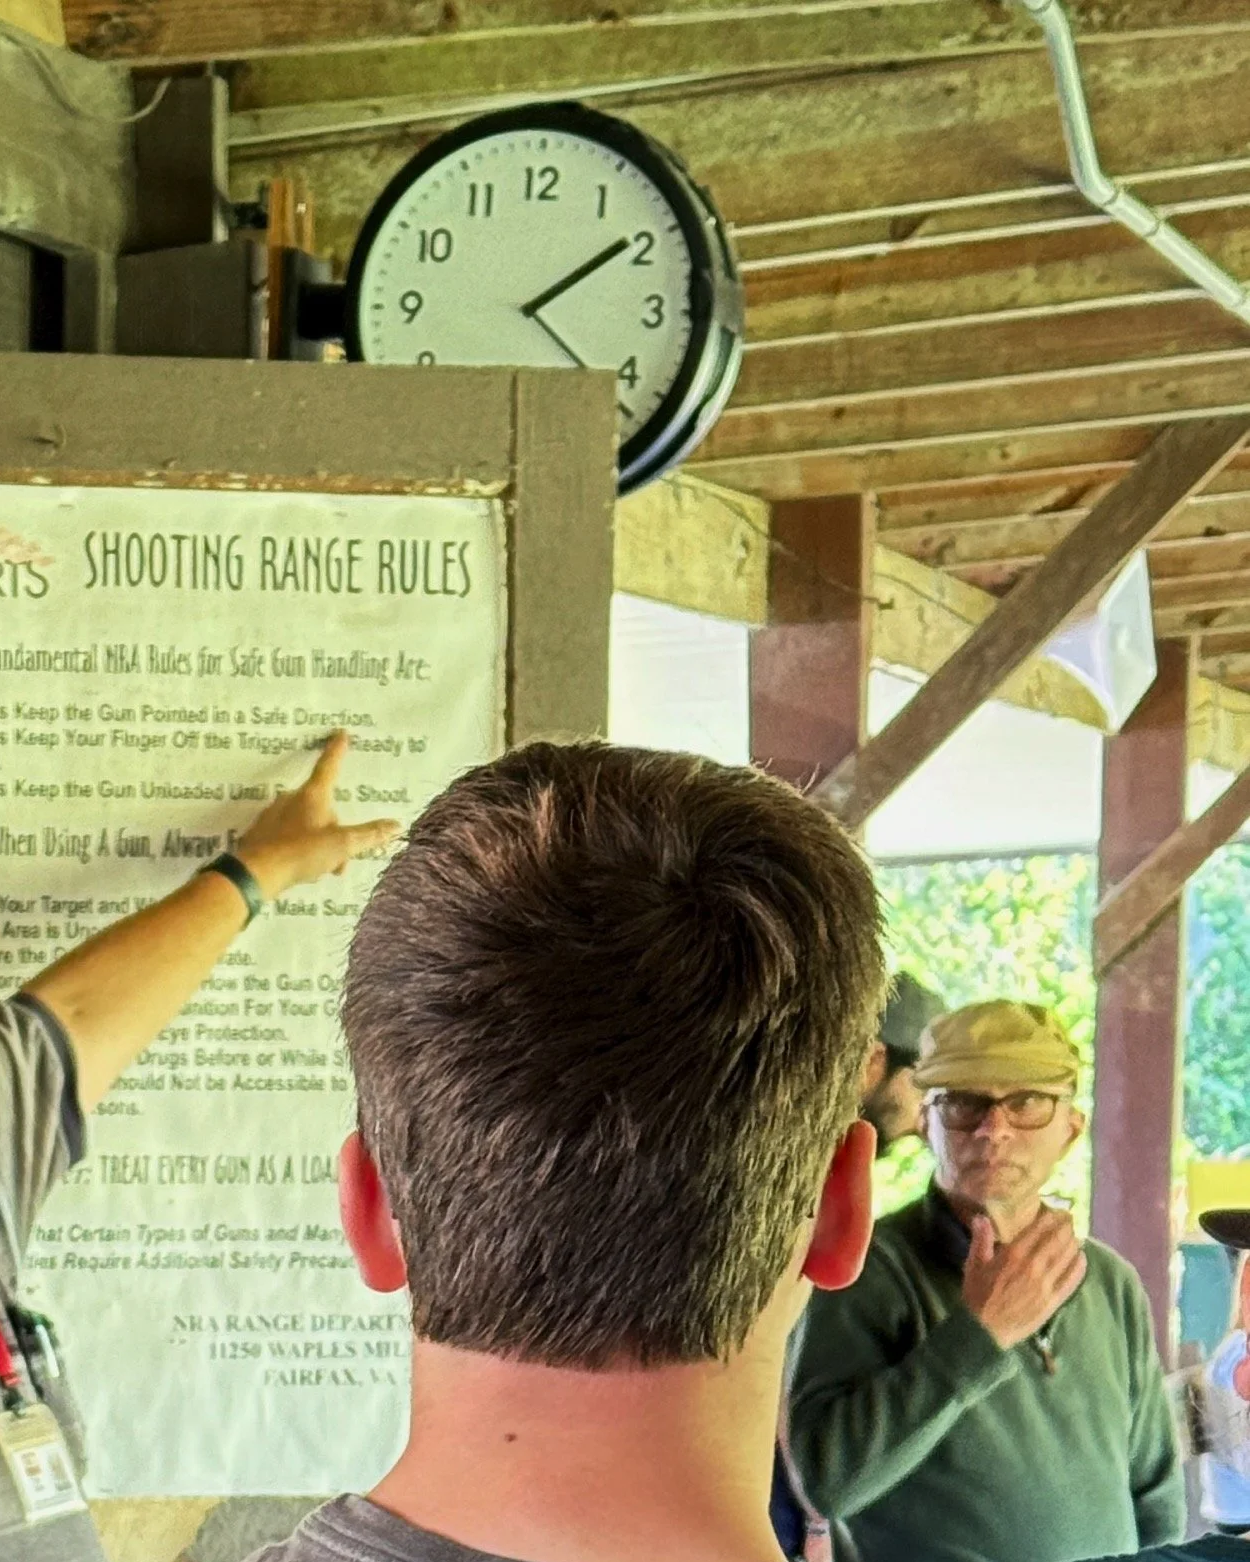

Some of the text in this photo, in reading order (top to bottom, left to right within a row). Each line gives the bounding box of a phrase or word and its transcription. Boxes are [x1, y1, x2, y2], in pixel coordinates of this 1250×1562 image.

[524, 166, 559, 201] 12
[468, 182, 494, 218] 11
[597, 184, 607, 219] 1
[418, 228, 453, 263] 10
[632, 231, 655, 266] 2
[399, 290, 424, 324] 9
[641, 294, 664, 329] 3
[617, 356, 641, 390] 4
[84, 531, 471, 599] SHOOTING RANGE RULES
[104, 643, 141, 674] NRA
[146, 644, 192, 676] Rules
[198, 646, 223, 678] for
[230, 647, 266, 678] Safe
[271, 647, 306, 678] Gun
[311, 648, 390, 686] Handling
[14, 702, 60, 724] Keep
[65, 702, 92, 721] the
[99, 703, 136, 722] Gun
[141, 704, 208, 724] Pointed
[212, 705, 230, 724] in
[234, 709, 246, 724] a
[251, 706, 288, 726] Safe
[14, 728, 60, 751] Keep
[63, 728, 107, 748] Your
[111, 728, 168, 752] Finger
[172, 731, 200, 750] Off
[204, 732, 231, 750] the
[238, 731, 298, 755] Trigger
[14, 779, 60, 801] Keep
[64, 779, 93, 798] the
[99, 780, 136, 799] Gun
[141, 781, 224, 800] Unloaded
[42, 826, 92, 864] Using
[97, 828, 110, 858] A
[40, 896, 94, 918] Target
[98, 898, 130, 914] and
[2, 921, 41, 939] Area
[46, 922, 60, 939] is
[18, 947, 46, 964] the
[243, 974, 270, 991] the
[276, 974, 313, 991] Gun
[243, 999, 274, 1016] For
[278, 999, 319, 1016] Your
[194, 1049, 250, 1067] Before
[256, 1052, 275, 1067] or
[280, 1050, 327, 1067] While
[110, 1073, 164, 1091] hould
[169, 1074, 201, 1091] Not
[205, 1074, 226, 1091] be
[231, 1074, 327, 1092] Accessible
[99, 1154, 150, 1185] TREAT
[157, 1154, 209, 1185] EVERY
[214, 1155, 250, 1185] GUN
[256, 1155, 276, 1185] AS
[282, 1155, 294, 1185] A
[301, 1155, 339, 1185] LOA
[35, 1224, 63, 1242] hat
[68, 1223, 130, 1242] Certain
[137, 1223, 186, 1246] Types
[191, 1223, 211, 1243] of
[214, 1223, 259, 1243] Guns
[264, 1224, 299, 1242] and
[62, 1252, 132, 1273] Require
[135, 1251, 225, 1270] Additional
[229, 1251, 285, 1273] Safety
[225, 1314, 306, 1333] RANGE
